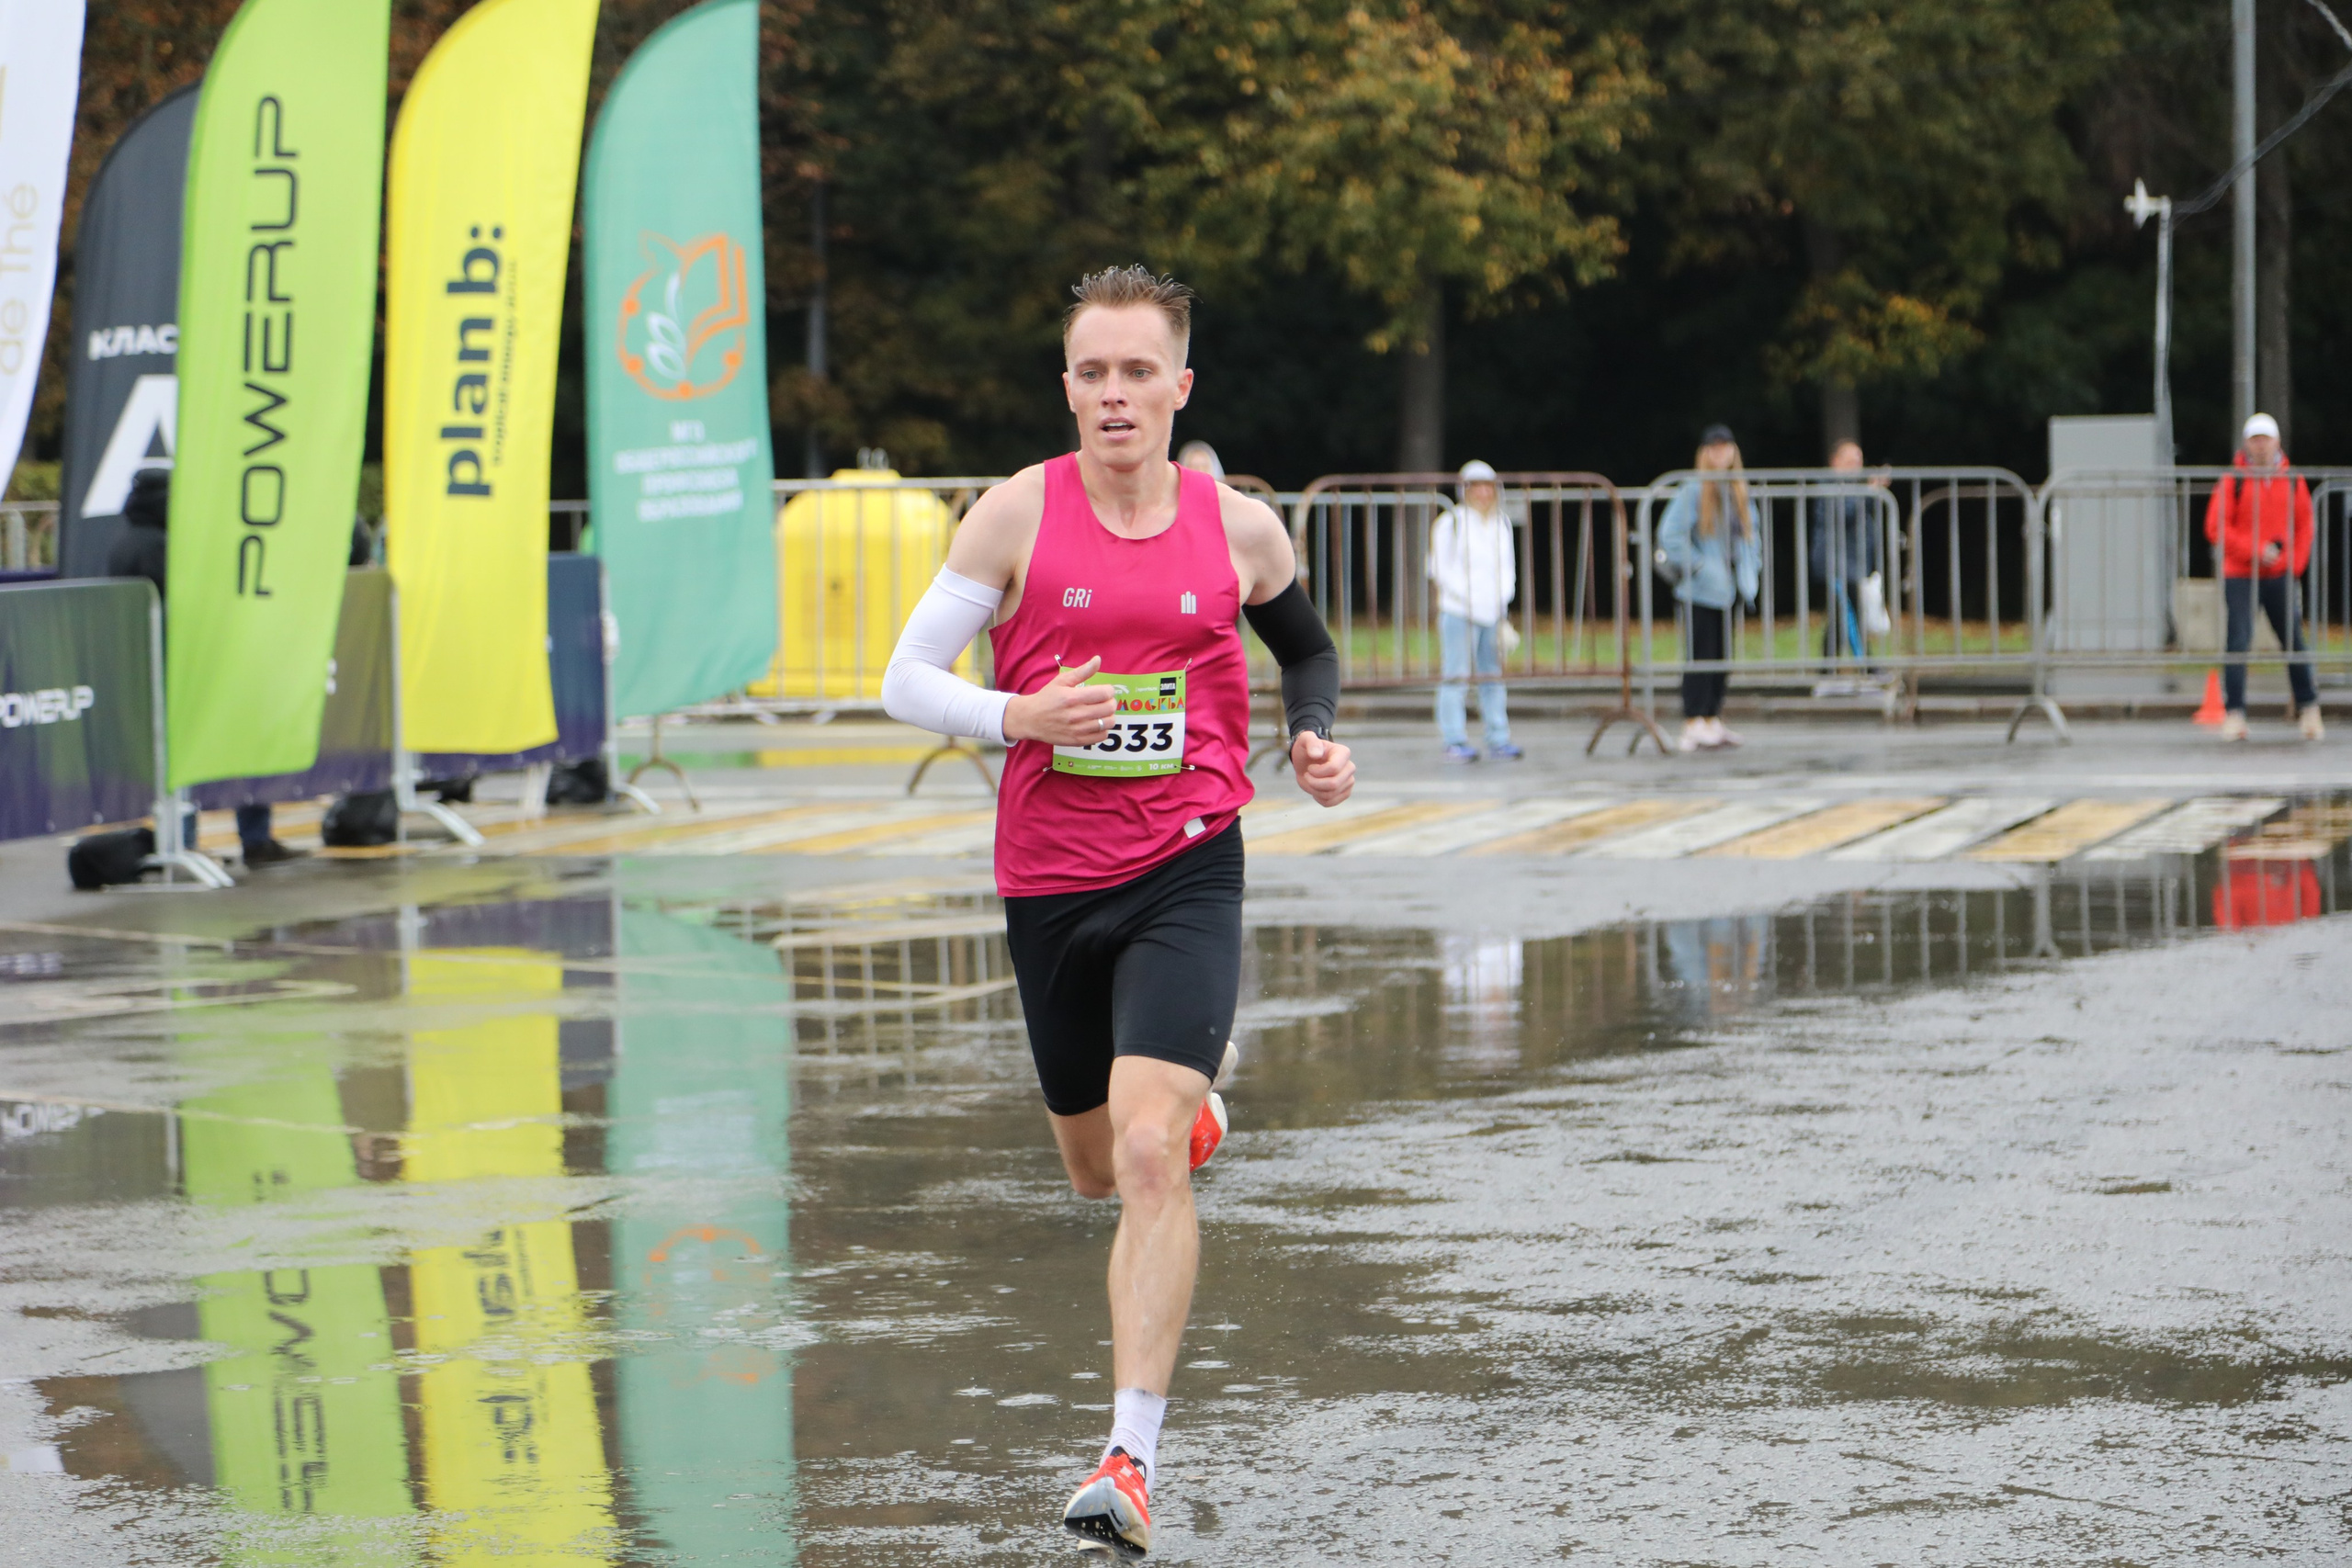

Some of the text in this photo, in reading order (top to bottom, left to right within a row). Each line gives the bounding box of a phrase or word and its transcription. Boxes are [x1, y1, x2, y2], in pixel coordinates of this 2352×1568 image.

[238, 95, 299, 598] POWERUP
[440, 314, 494, 497] plan
[1082, 722, 1174, 752] 533
[1116, 697, 1184, 711] МОСКВА
